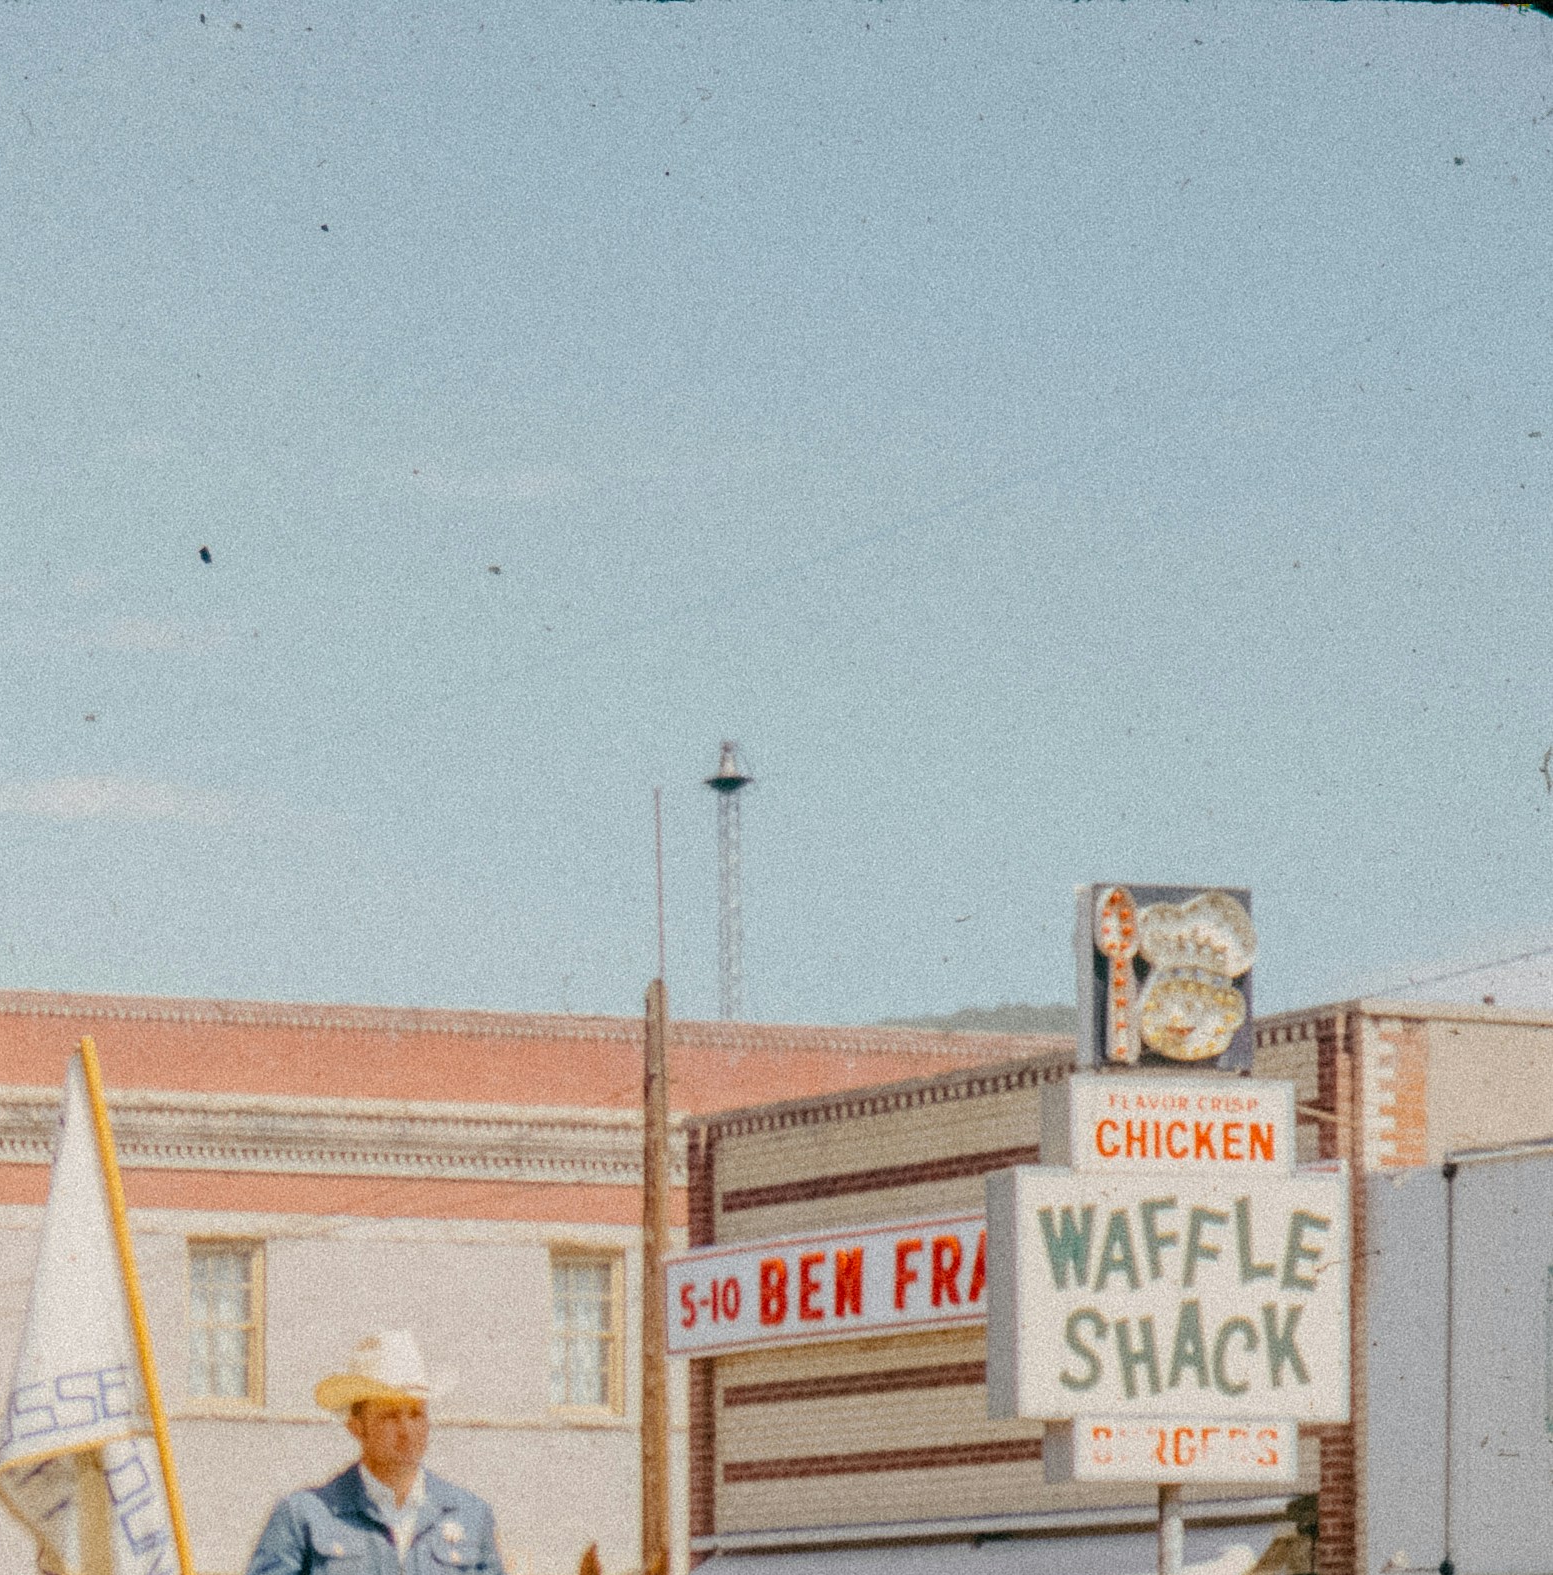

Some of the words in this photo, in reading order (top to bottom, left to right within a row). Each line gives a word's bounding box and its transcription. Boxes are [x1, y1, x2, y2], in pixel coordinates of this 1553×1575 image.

[1095, 1119, 1276, 1161] CHICKEN
[1037, 1196, 1332, 1293] WAFFLE
[679, 1276, 742, 1330] 5-10
[759, 1247, 865, 1327] BEN
[1059, 1298, 1312, 1400] SHACK
[0, 1365, 132, 1446] SSE
